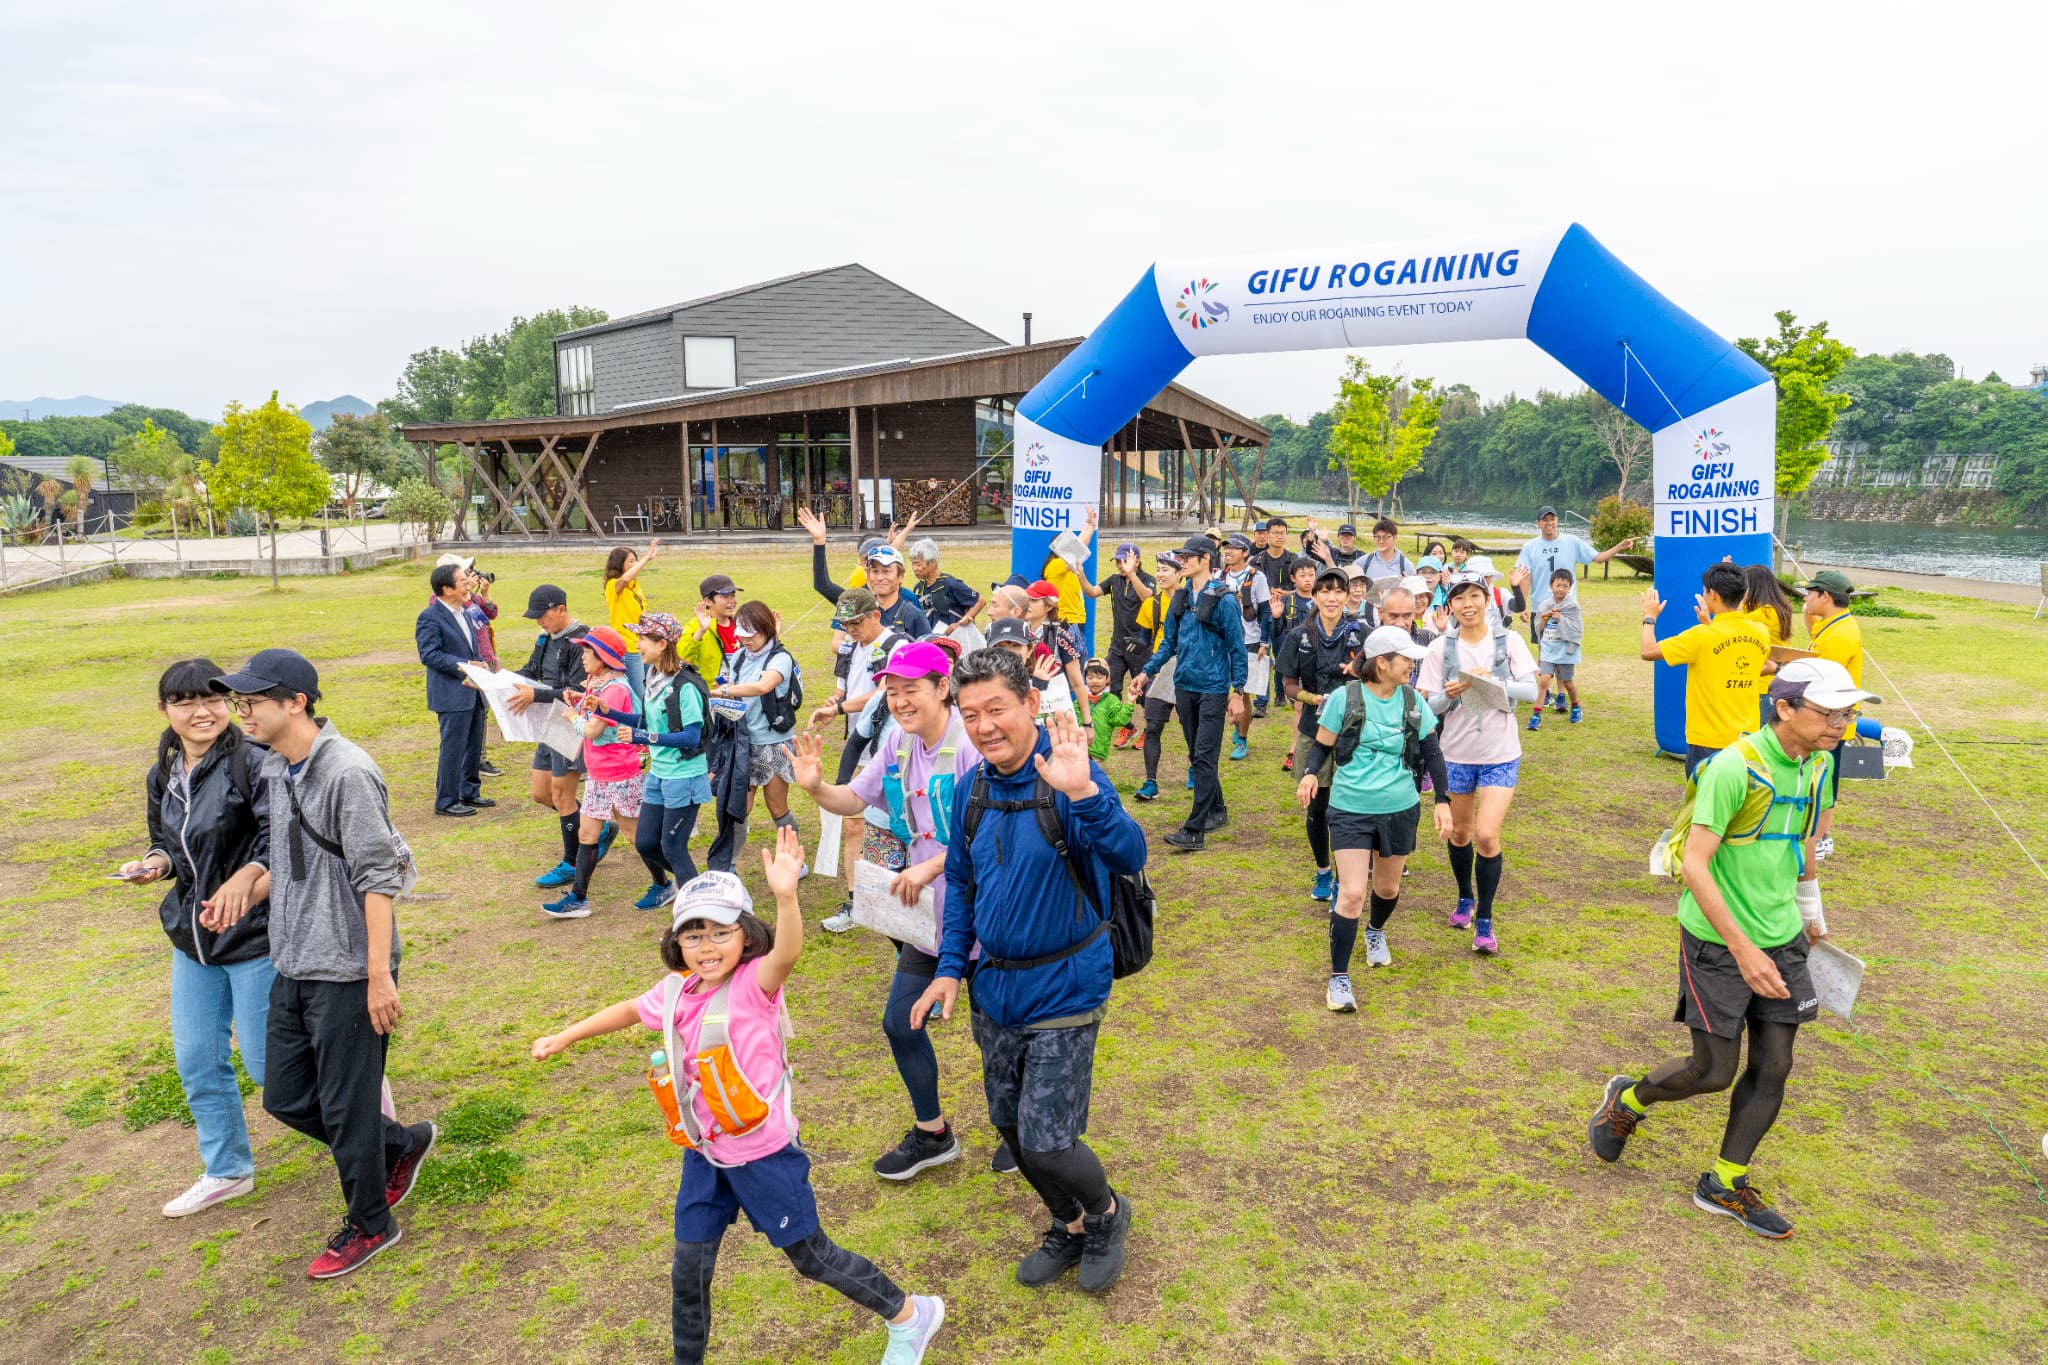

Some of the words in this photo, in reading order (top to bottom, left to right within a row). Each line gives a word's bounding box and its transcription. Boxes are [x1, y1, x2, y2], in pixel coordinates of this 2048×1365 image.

[1247, 266, 1321, 295] GIFU
[1327, 249, 1520, 288] ROGAINING
[1253, 312, 1289, 325] ENJOY
[1291, 309, 1317, 323] OUR
[1319, 305, 1385, 320] ROGAINING
[1388, 303, 1426, 317] EVENT
[1429, 300, 1473, 315] TODAY
[1024, 470, 1051, 484] GIFU
[1691, 462, 1734, 480] GIFU
[1668, 479, 1759, 500] ROGAINING
[1014, 505, 1070, 528] FINISH
[1670, 507, 1757, 535] FINISH
[1713, 639, 1731, 655] GIFU
[1732, 635, 1767, 655] ROGAINING
[1726, 680, 1753, 688] STAFF
